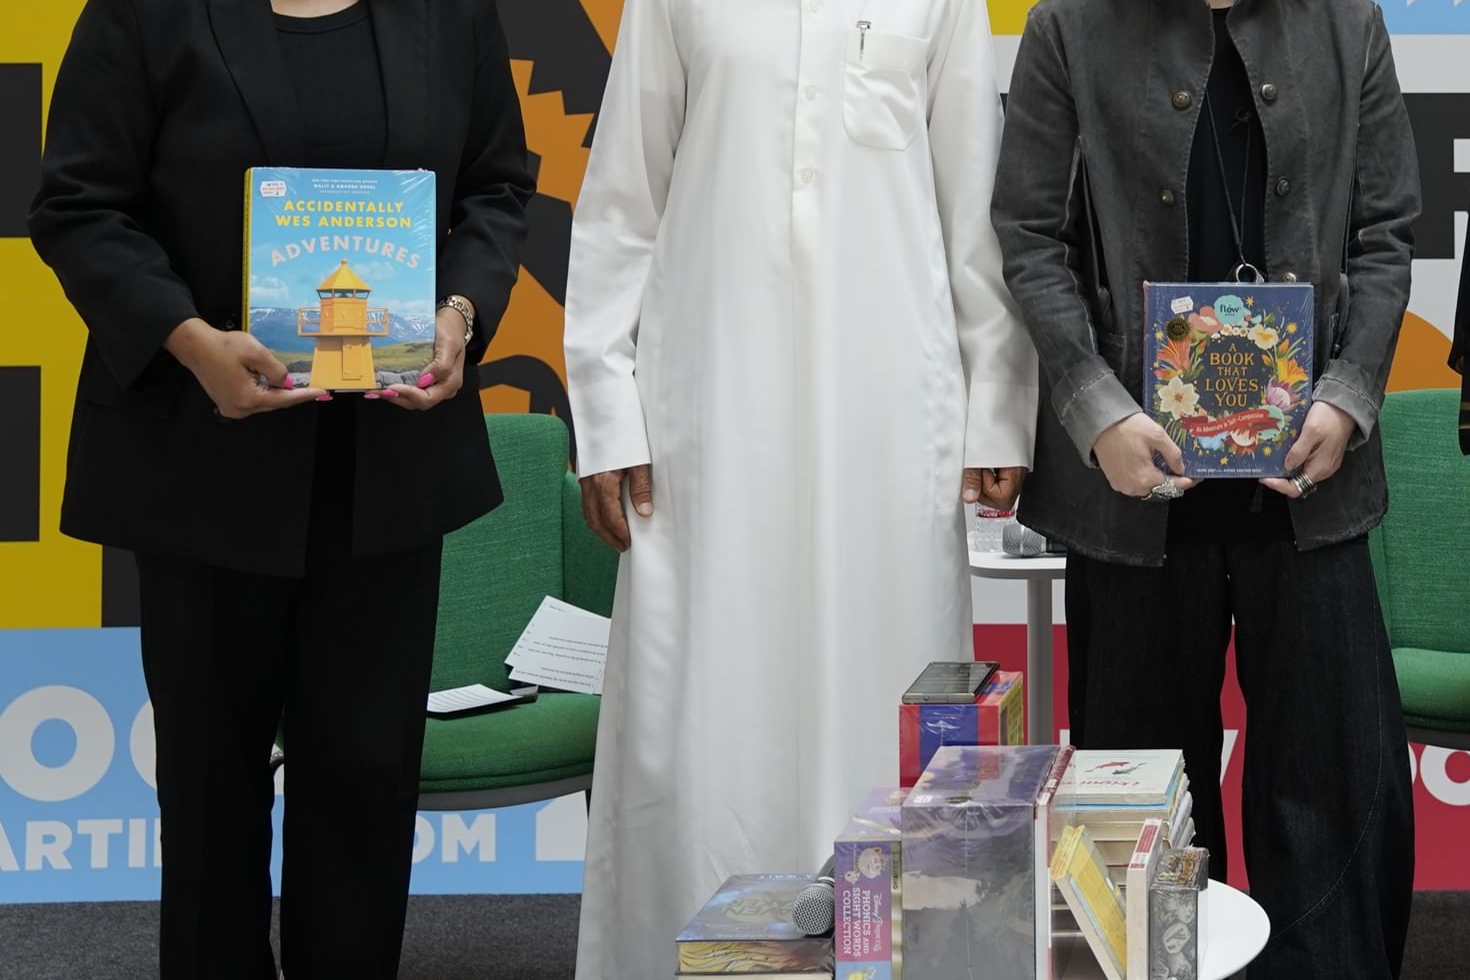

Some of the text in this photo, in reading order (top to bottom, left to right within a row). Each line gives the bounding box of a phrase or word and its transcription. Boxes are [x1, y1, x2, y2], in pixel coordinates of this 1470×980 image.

[284, 200, 405, 213] ACCIDENTALLY
[275, 215, 412, 228] WES ANDERSON
[270, 234, 422, 269] ADVENTURES
[1228, 343, 1237, 352] A
[1209, 352, 1254, 365] BOOK
[1217, 367, 1248, 376] THAT
[1205, 377, 1259, 392] LOVES
[1214, 391, 1248, 407] YOU
[862, 890, 871, 935] PHONICS
[842, 890, 852, 955] COLLECTION
[853, 887, 862, 957] SIGHT WORDS
